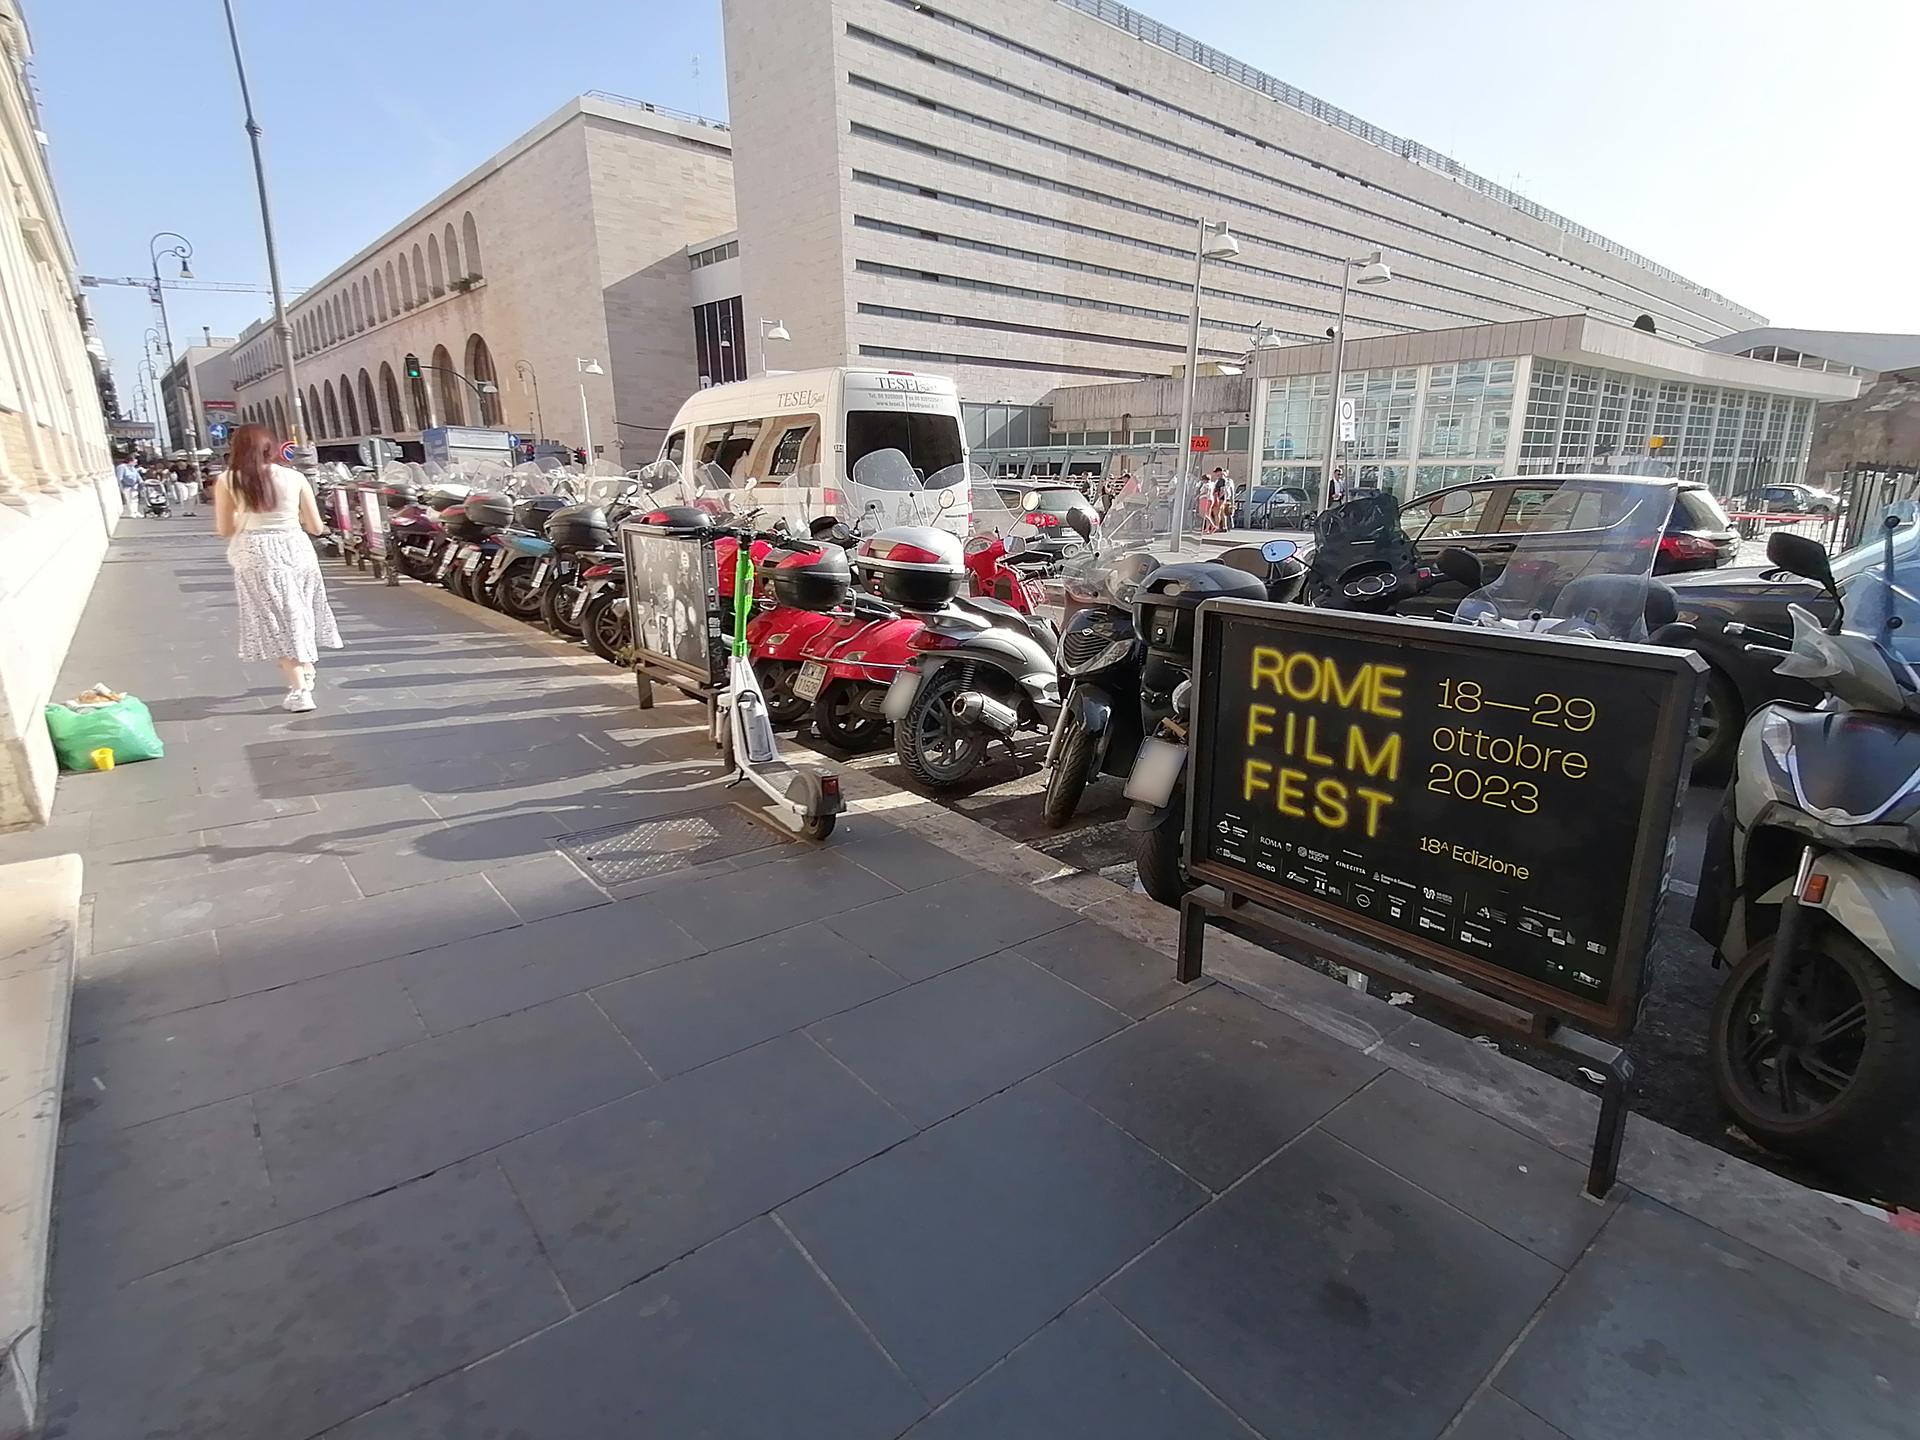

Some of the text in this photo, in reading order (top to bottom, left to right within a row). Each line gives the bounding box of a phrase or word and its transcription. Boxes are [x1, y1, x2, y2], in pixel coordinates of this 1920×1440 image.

[777, 390, 812, 407] TESEI
[875, 377, 919, 392] TESEI
[1191, 439, 1209, 448] TAXI
[1251, 645, 1406, 718] ROME
[1247, 703, 1401, 782] FILM
[1432, 726, 1589, 779] ottobre
[1243, 759, 1394, 838] FEST
[1427, 763, 1540, 814] 2023
[1259, 836, 1282, 850] ROMA
[1256, 861, 1276, 873] acea
[1452, 845, 1530, 880] Edizione
